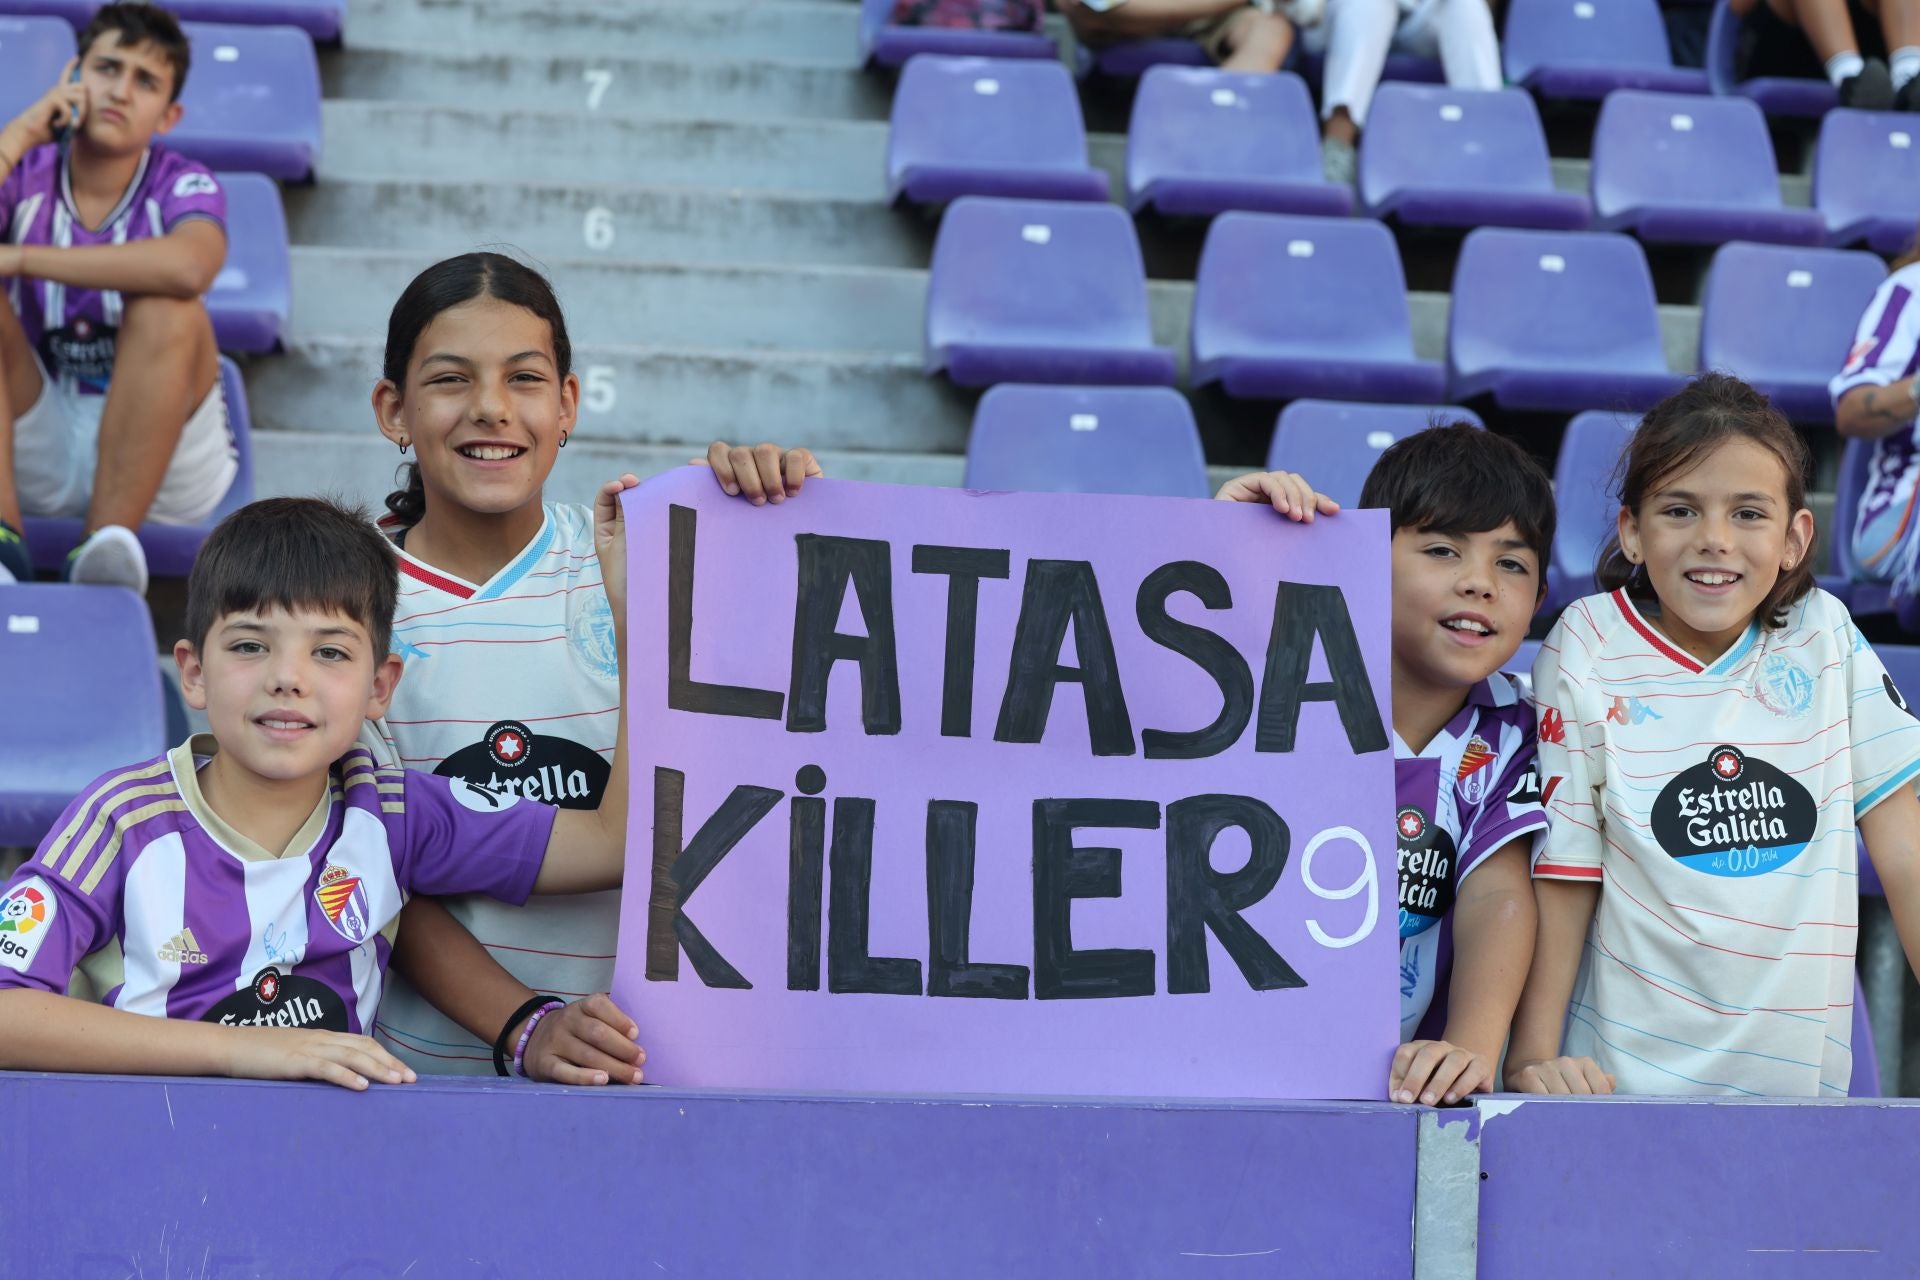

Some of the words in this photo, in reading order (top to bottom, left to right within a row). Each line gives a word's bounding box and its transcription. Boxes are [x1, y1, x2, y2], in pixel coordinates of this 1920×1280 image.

[583, 70, 613, 110] 7
[583, 207, 614, 250] 6
[584, 365, 616, 412] 5
[667, 503, 1390, 759] LATASA
[450, 764, 591, 801] trella
[1678, 782, 1787, 818] Estrella
[1686, 812, 1789, 847] Galicia
[1397, 847, 1449, 880] rella
[1301, 825, 1380, 948] 9
[1398, 874, 1438, 909] icia
[0, 934, 28, 959] iga
[157, 949, 209, 964] adidas
